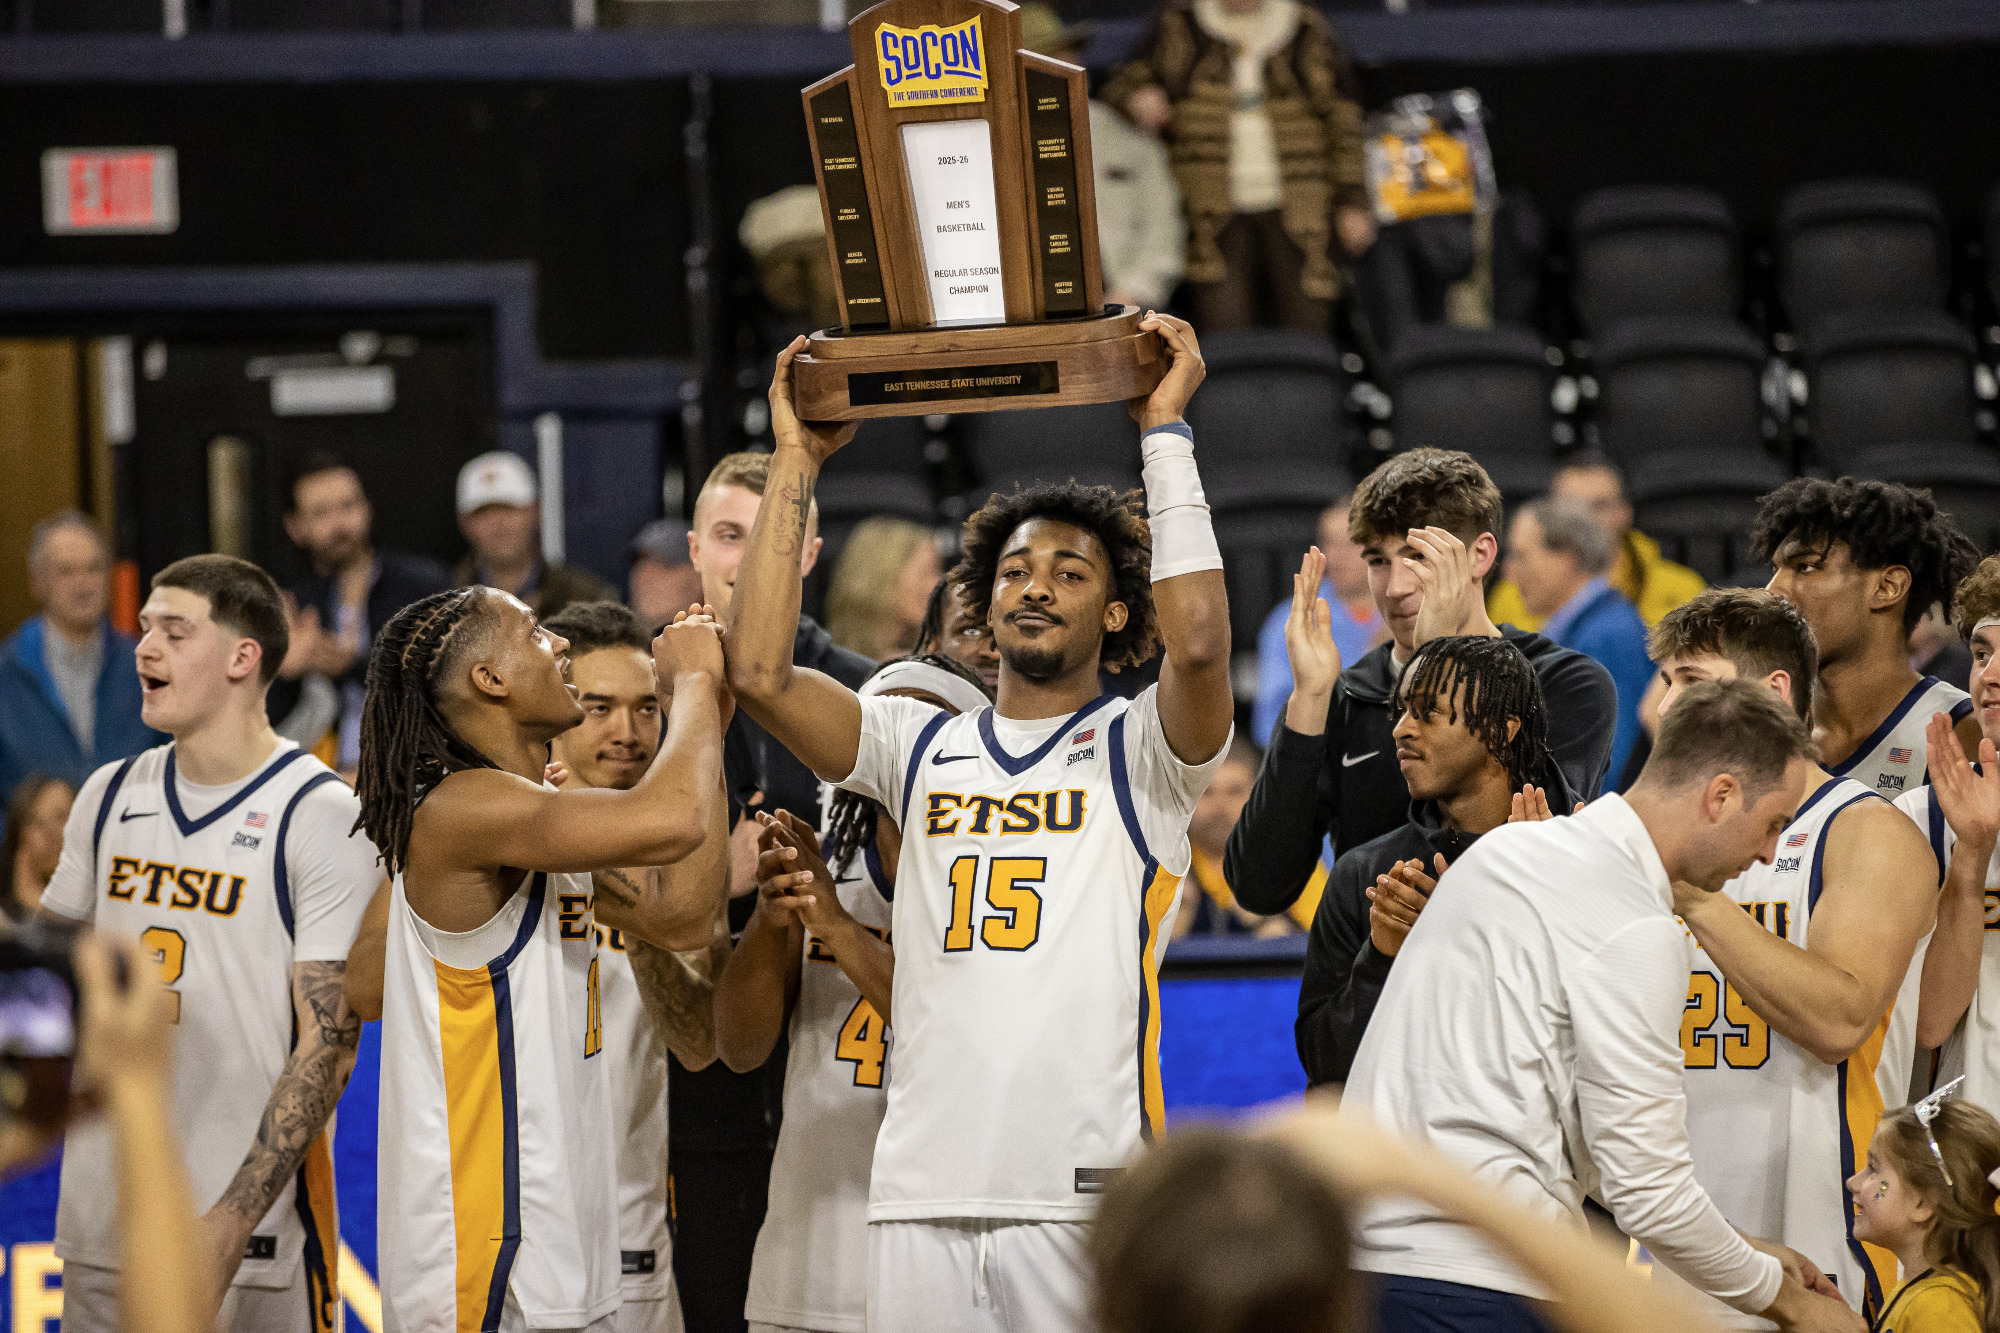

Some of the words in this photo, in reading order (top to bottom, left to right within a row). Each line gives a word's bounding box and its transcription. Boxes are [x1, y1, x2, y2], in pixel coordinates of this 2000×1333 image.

[894, 91, 905, 101] THE
[906, 89, 939, 100] SOUTHERN
[939, 87, 979, 98] CONFERENCE
[937, 155, 969, 165] 2025-26
[946, 200, 970, 209] MEN'S
[936, 222, 986, 234] BASKETBALL
[934, 268, 969, 278] REGULAR
[969, 266, 1000, 277] SEASON
[949, 285, 989, 295] CHAMPION
[884, 382, 905, 392] EAST
[906, 379, 950, 391] TENNESSEE
[951, 378, 975, 388] STATE
[975, 375, 1022, 386] UNIVERSITY
[925, 788, 1088, 838] ETSU
[107, 855, 248, 919] ETSU
[943, 854, 1048, 953] 15
[1679, 970, 1771, 1070] 25
